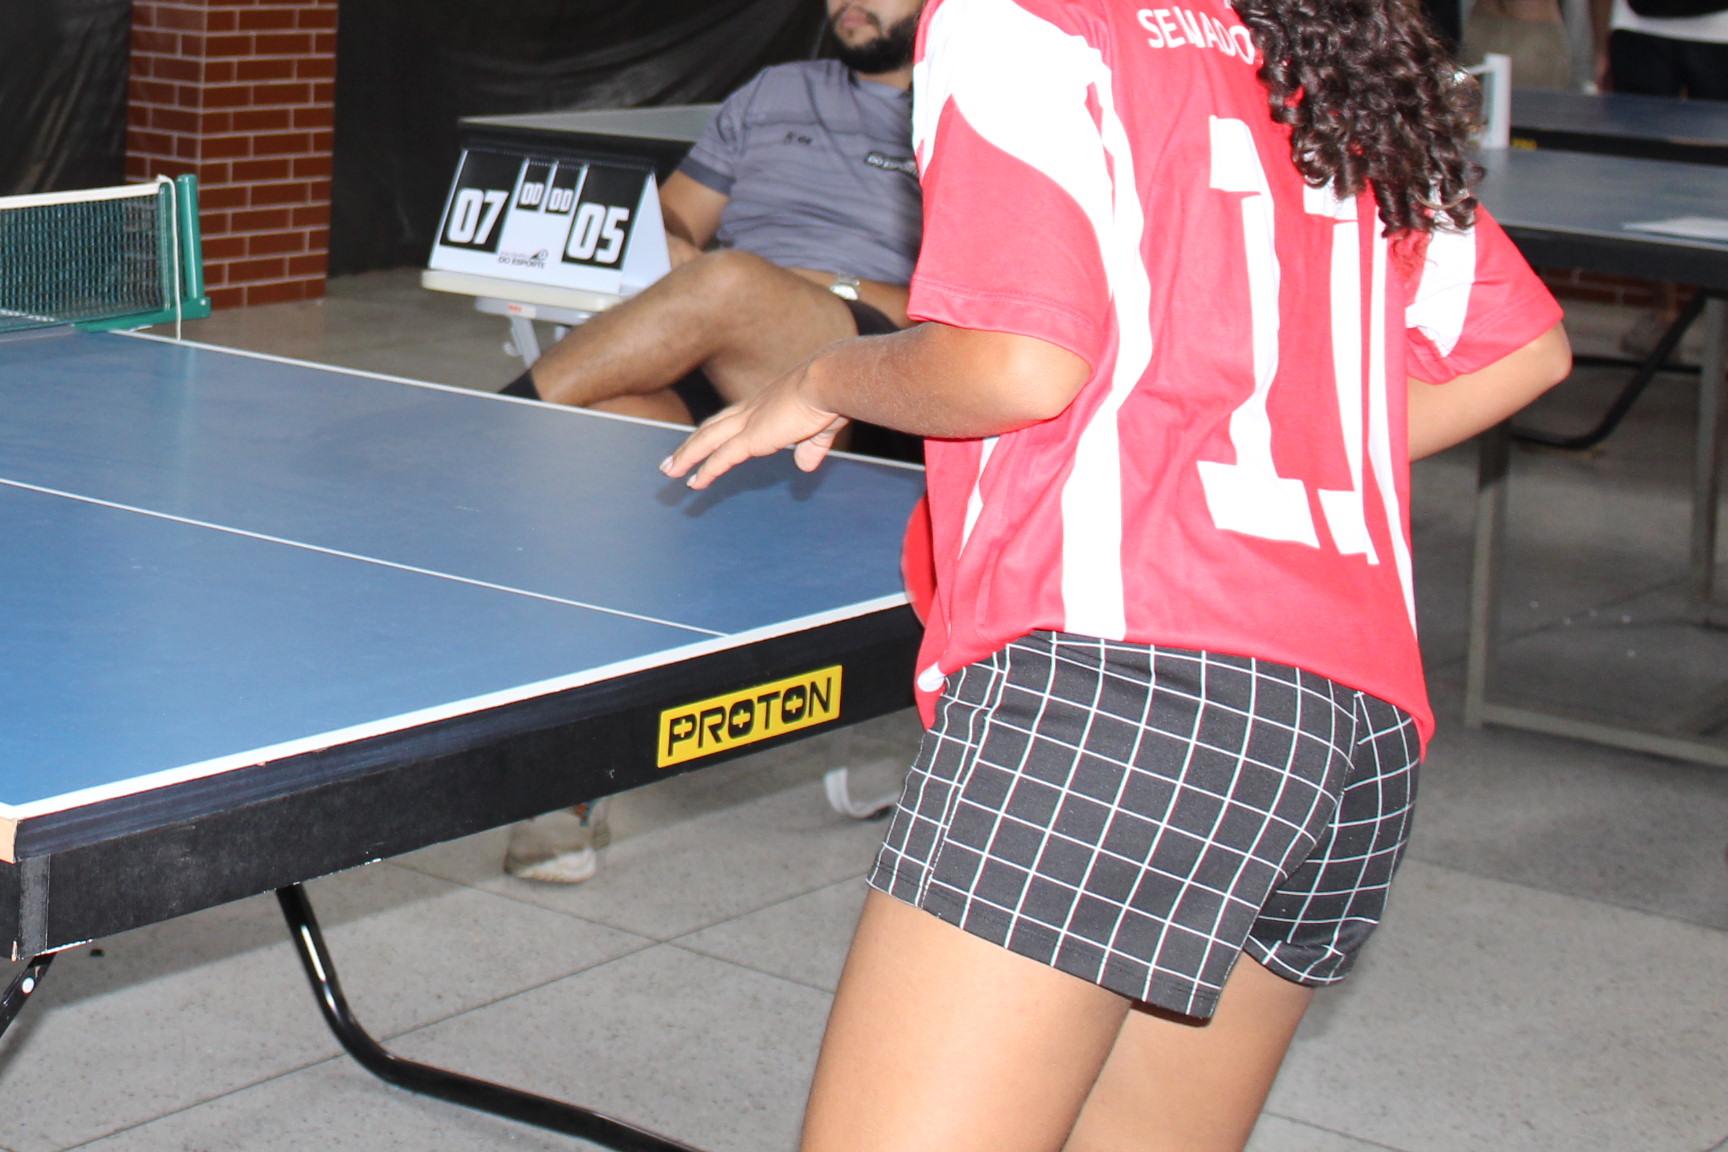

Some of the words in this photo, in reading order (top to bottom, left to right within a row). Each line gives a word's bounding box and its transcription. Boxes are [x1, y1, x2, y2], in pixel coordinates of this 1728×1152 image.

[1137, 6, 1263, 65] SENADO
[447, 188, 509, 244] 07
[519, 182, 544, 205] 00
[547, 188, 573, 212] 00
[567, 202, 629, 264] 05
[668, 677, 832, 757] PROTON
